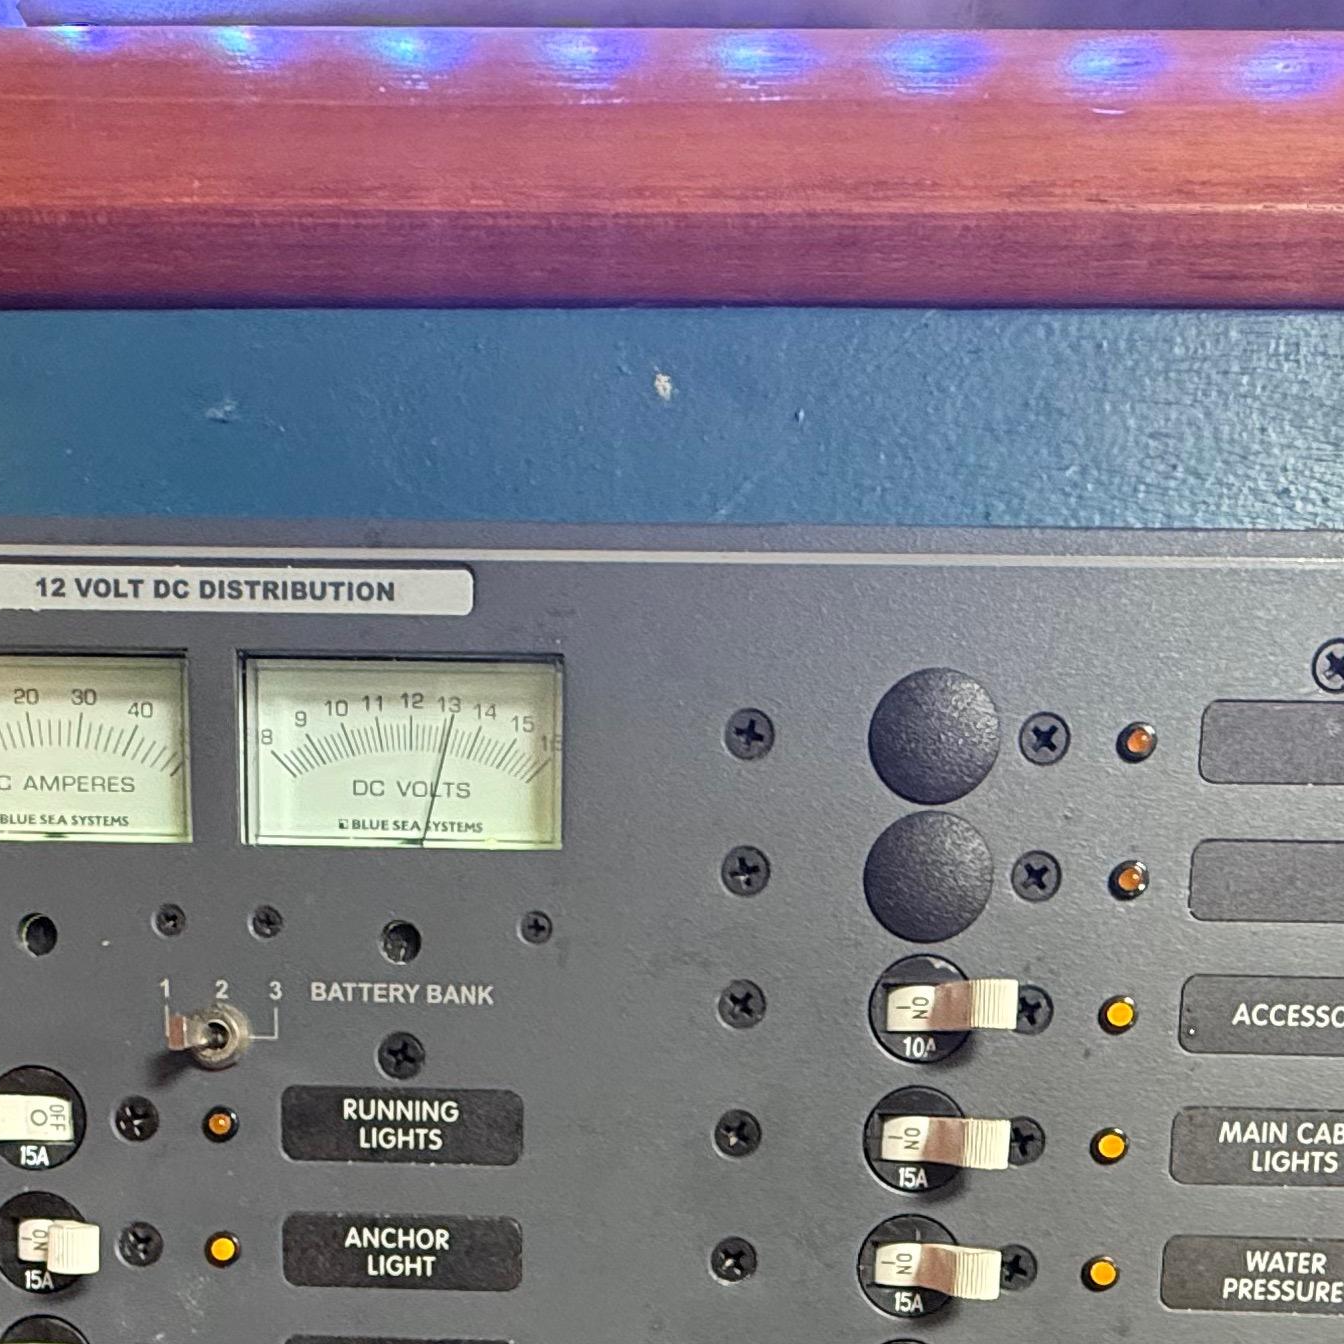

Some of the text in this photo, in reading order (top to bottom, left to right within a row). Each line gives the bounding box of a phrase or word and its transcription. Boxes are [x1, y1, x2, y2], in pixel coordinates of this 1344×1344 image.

[35, 577, 396, 602] 12 VOLT DC DISTRIBUTION
[13, 688, 39, 705] 20
[71, 688, 97, 706] 30
[128, 701, 154, 719] 40
[260, 729, 273, 745] 8
[294, 710, 307, 728] 9
[324, 699, 349, 717] 10
[363, 695, 383, 712] 11
[401, 692, 425, 710] 12
[437, 695, 462, 715] 13
[473, 702, 497, 721] 14
[512, 715, 535, 733] 15
[23, 774, 137, 794] AMPERES
[352, 779, 472, 799] DC VOLTS
[0, 813, 130, 828] BLUE SEA SYSTEMS
[351, 818, 389, 831] BLUE
[392, 819, 422, 832] SEA
[160, 978, 170, 998] 1
[215, 979, 229, 1000] 2
[269, 980, 283, 1001] 3
[310, 981, 494, 1006] BATTERY BANK
[343, 1098, 459, 1123] RUNNING
[359, 1126, 443, 1151] LIGHTS
[1218, 1120, 1288, 1144] MAIN
[20, 1145, 50, 1167] 15A
[1251, 1150, 1339, 1174] LIGHTS
[898, 1167, 928, 1188] 15A
[344, 1226, 450, 1251] ANCHOR
[367, 1254, 437, 1277] LIGHT
[1246, 1250, 1327, 1275] WATER
[24, 1270, 54, 1290] 15A
[1222, 1278, 1344, 1304] PRESSURE
[894, 1292, 924, 1313] 15A
